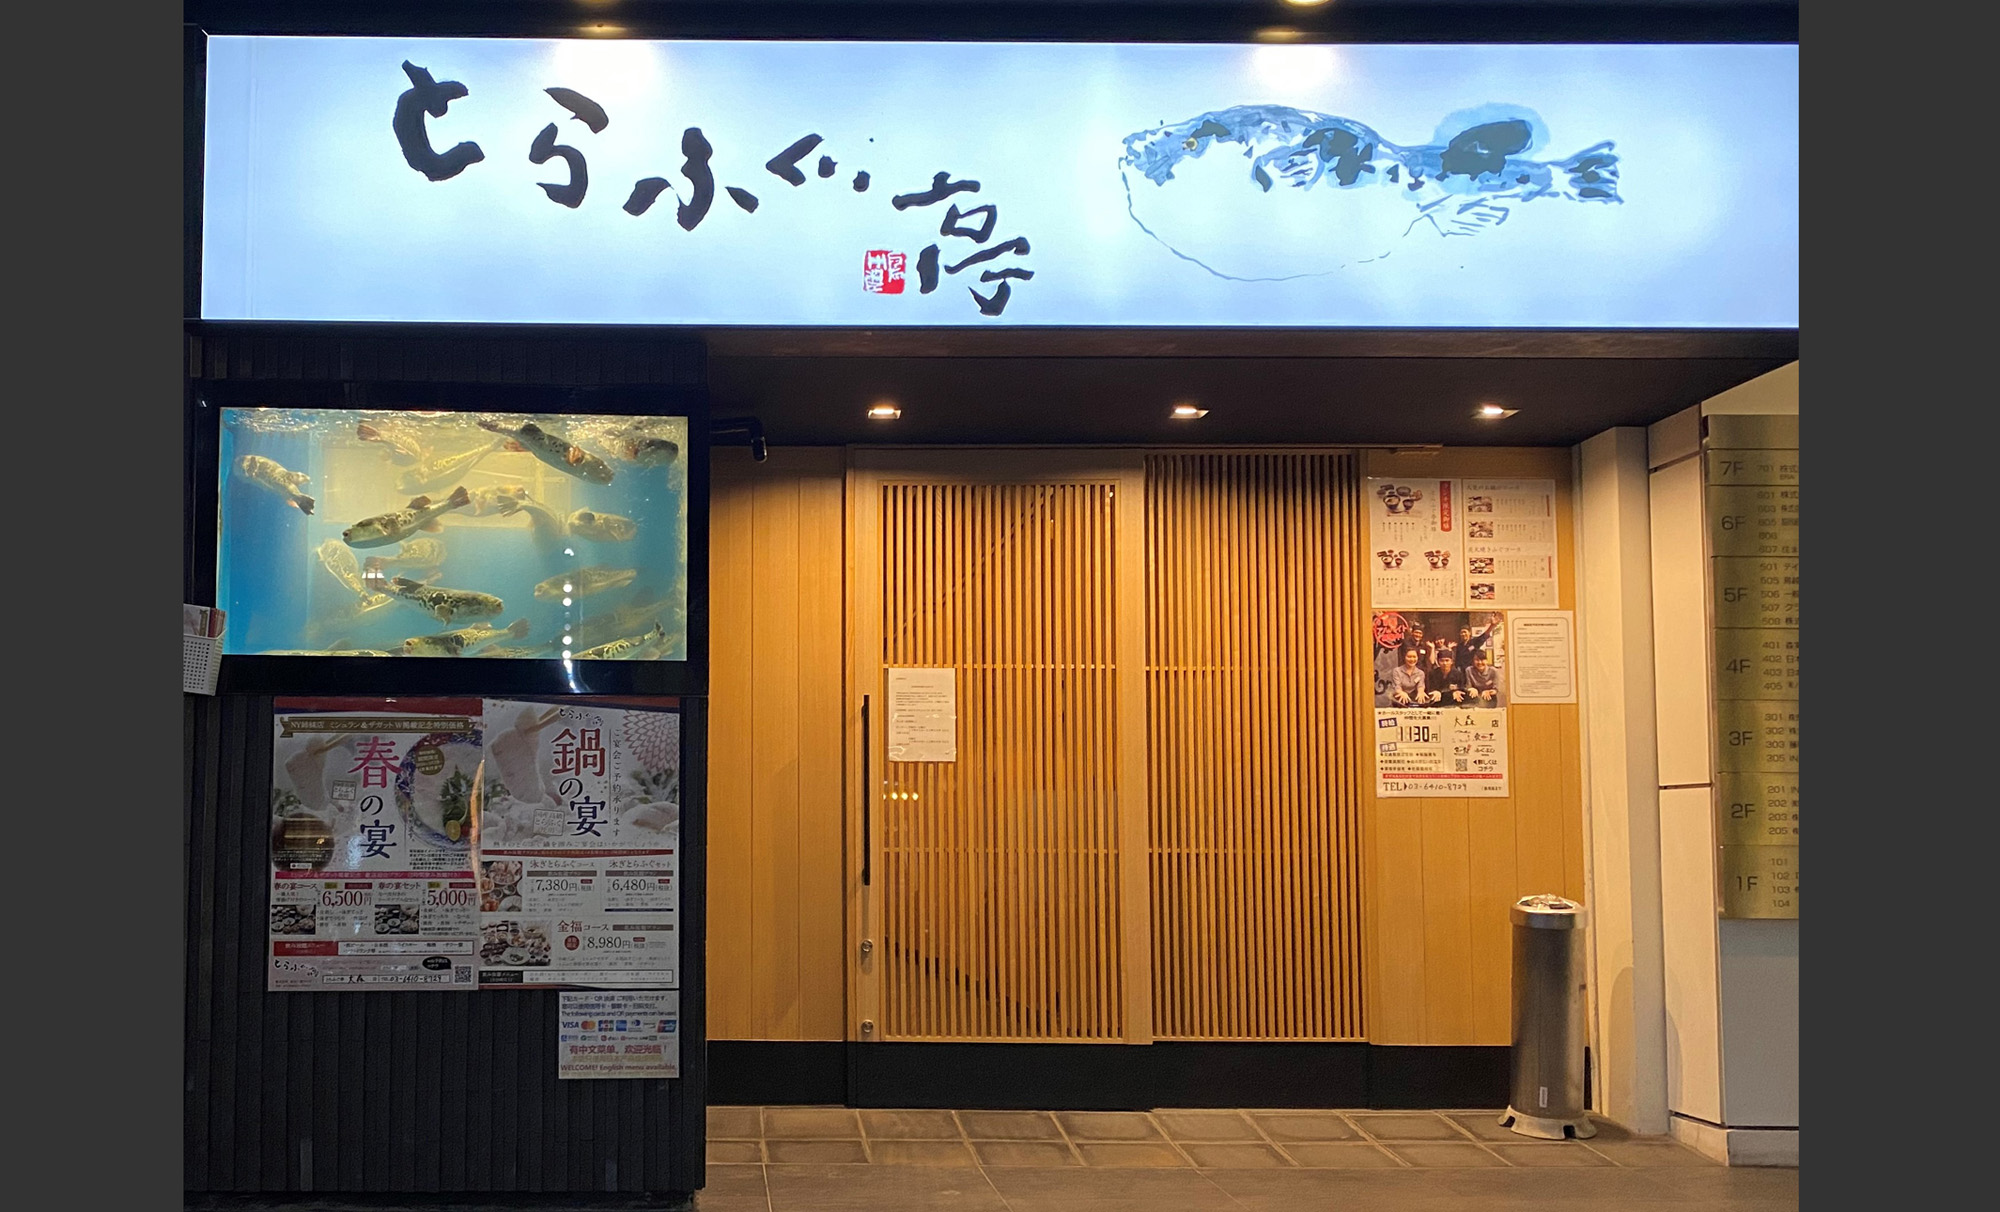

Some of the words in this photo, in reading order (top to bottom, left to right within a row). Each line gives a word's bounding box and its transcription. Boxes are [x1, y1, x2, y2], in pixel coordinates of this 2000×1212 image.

[393, 60, 1034, 316] とらふぐ亭
[1720, 461, 1744, 475] 7F
[1721, 516, 1746, 530] 6F
[1724, 588, 1748, 602] 5F
[1727, 659, 1750, 673] 4F
[1729, 731, 1752, 746] 3F
[551, 728, 609, 837] 鍋の宴
[1383, 782, 1402, 791] TEL
[348, 736, 401, 859] 春の宴
[1731, 804, 1755, 818] 2F
[1772, 872, 1789, 880] 102
[1736, 876, 1757, 891] 1F
[600, 1064, 624, 1072] English
